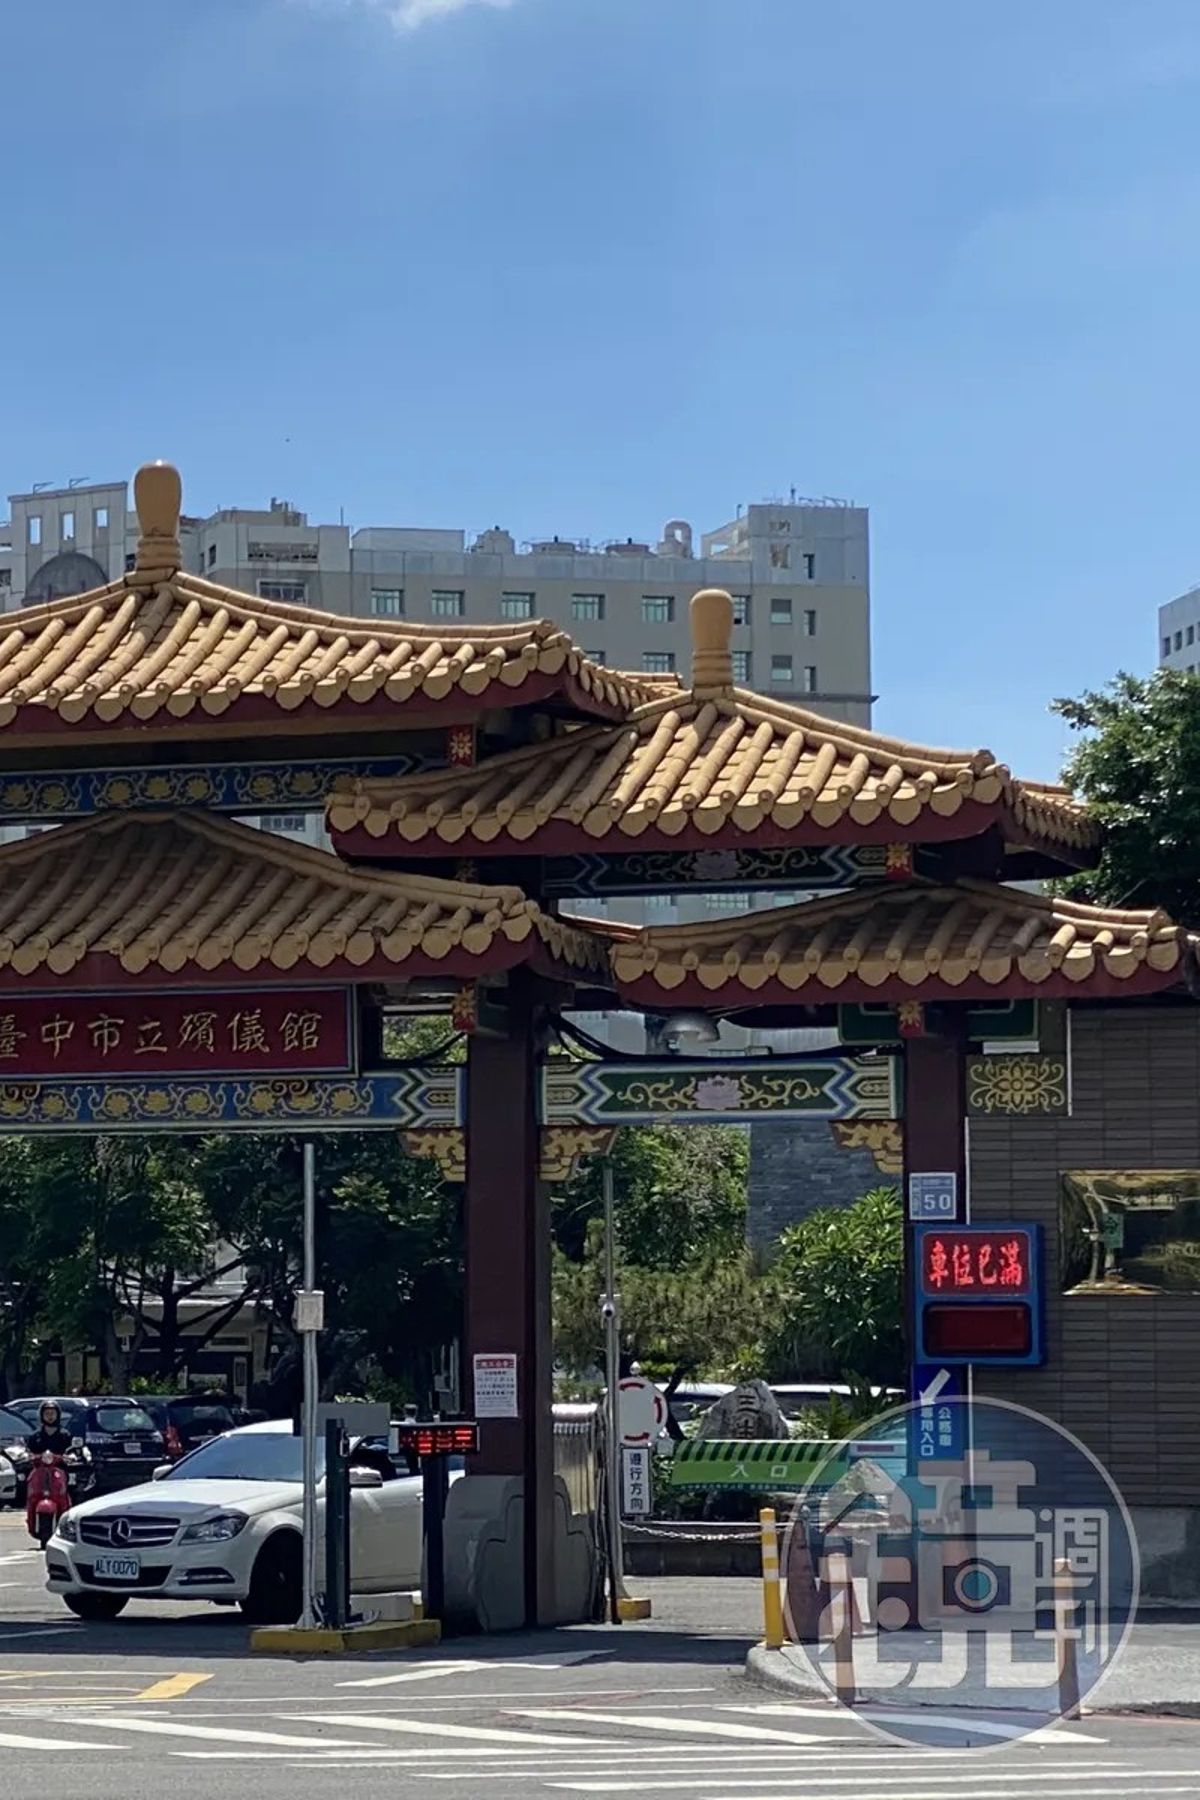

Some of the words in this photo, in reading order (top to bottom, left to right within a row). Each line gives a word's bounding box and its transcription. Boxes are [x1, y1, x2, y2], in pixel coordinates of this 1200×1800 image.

[924, 1193, 951, 1210] 50
[929, 1240, 1024, 1288] 車位已滿
[731, 1464, 788, 1478] 入口
